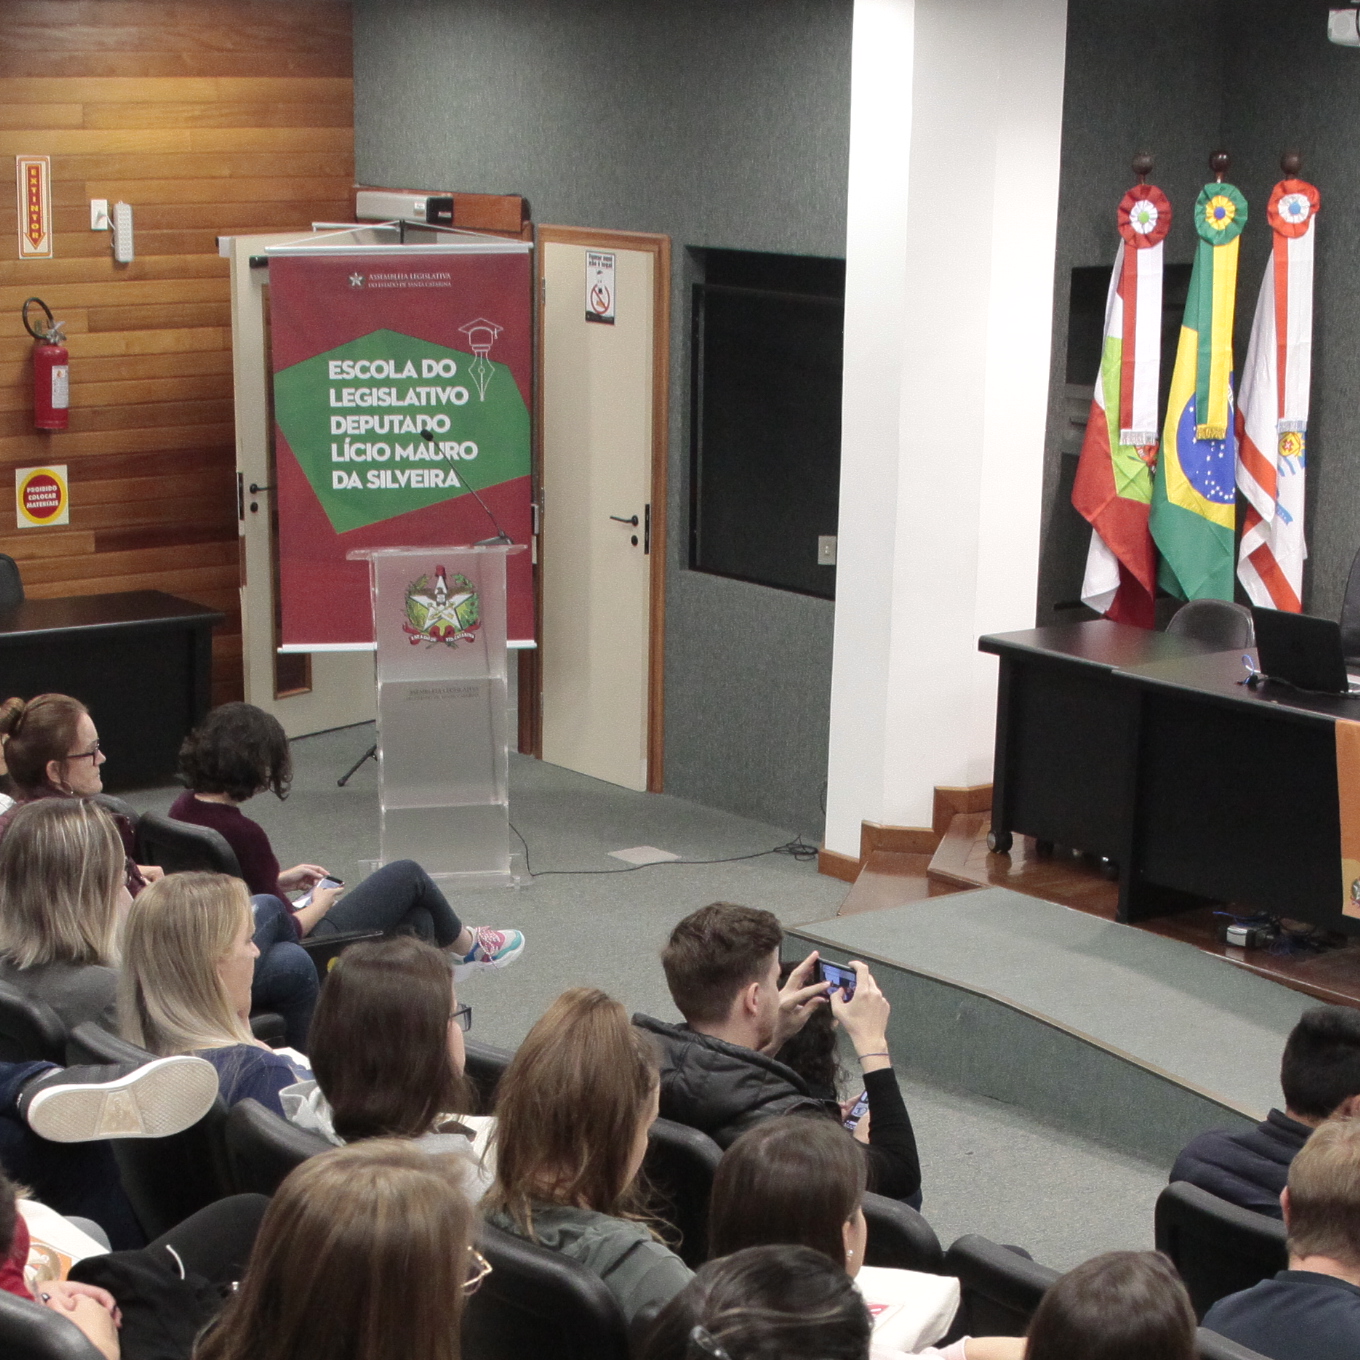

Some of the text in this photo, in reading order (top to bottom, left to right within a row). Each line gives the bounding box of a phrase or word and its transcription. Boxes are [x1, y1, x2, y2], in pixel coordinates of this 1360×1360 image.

[30, 168, 40, 239] EXTINTOR
[409, 272, 451, 280] LEGISLATIVA
[328, 358, 457, 379] ESCOLA DO
[329, 386, 470, 407] LEGISLATIVO
[330, 413, 451, 434] DEPUTADO
[331, 437, 479, 462] LÍCIO MAURO
[26, 485, 57, 493] PROIBIDO
[332, 468, 461, 489] DA SILVEIRA
[26, 500, 58, 508] MATERIAIS
[28, 493, 57, 501] COLOCAR
